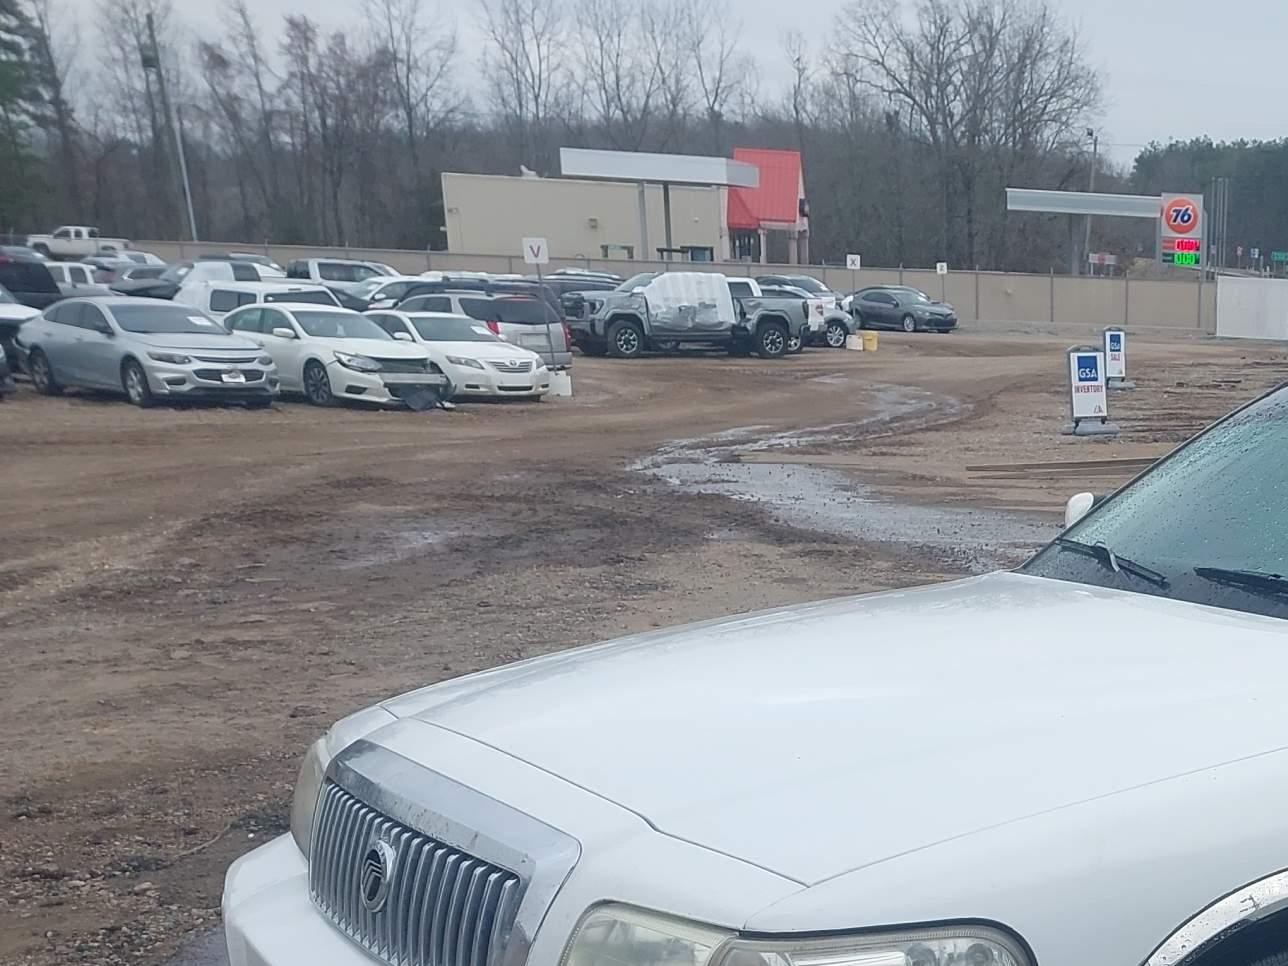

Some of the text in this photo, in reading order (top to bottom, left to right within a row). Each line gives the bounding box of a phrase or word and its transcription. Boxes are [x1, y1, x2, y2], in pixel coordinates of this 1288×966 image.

[1170, 205, 1193, 225] 76
[529, 244, 541, 258] V
[1078, 367, 1098, 379] GSA
[1074, 384, 1103, 393] INVENTORY
